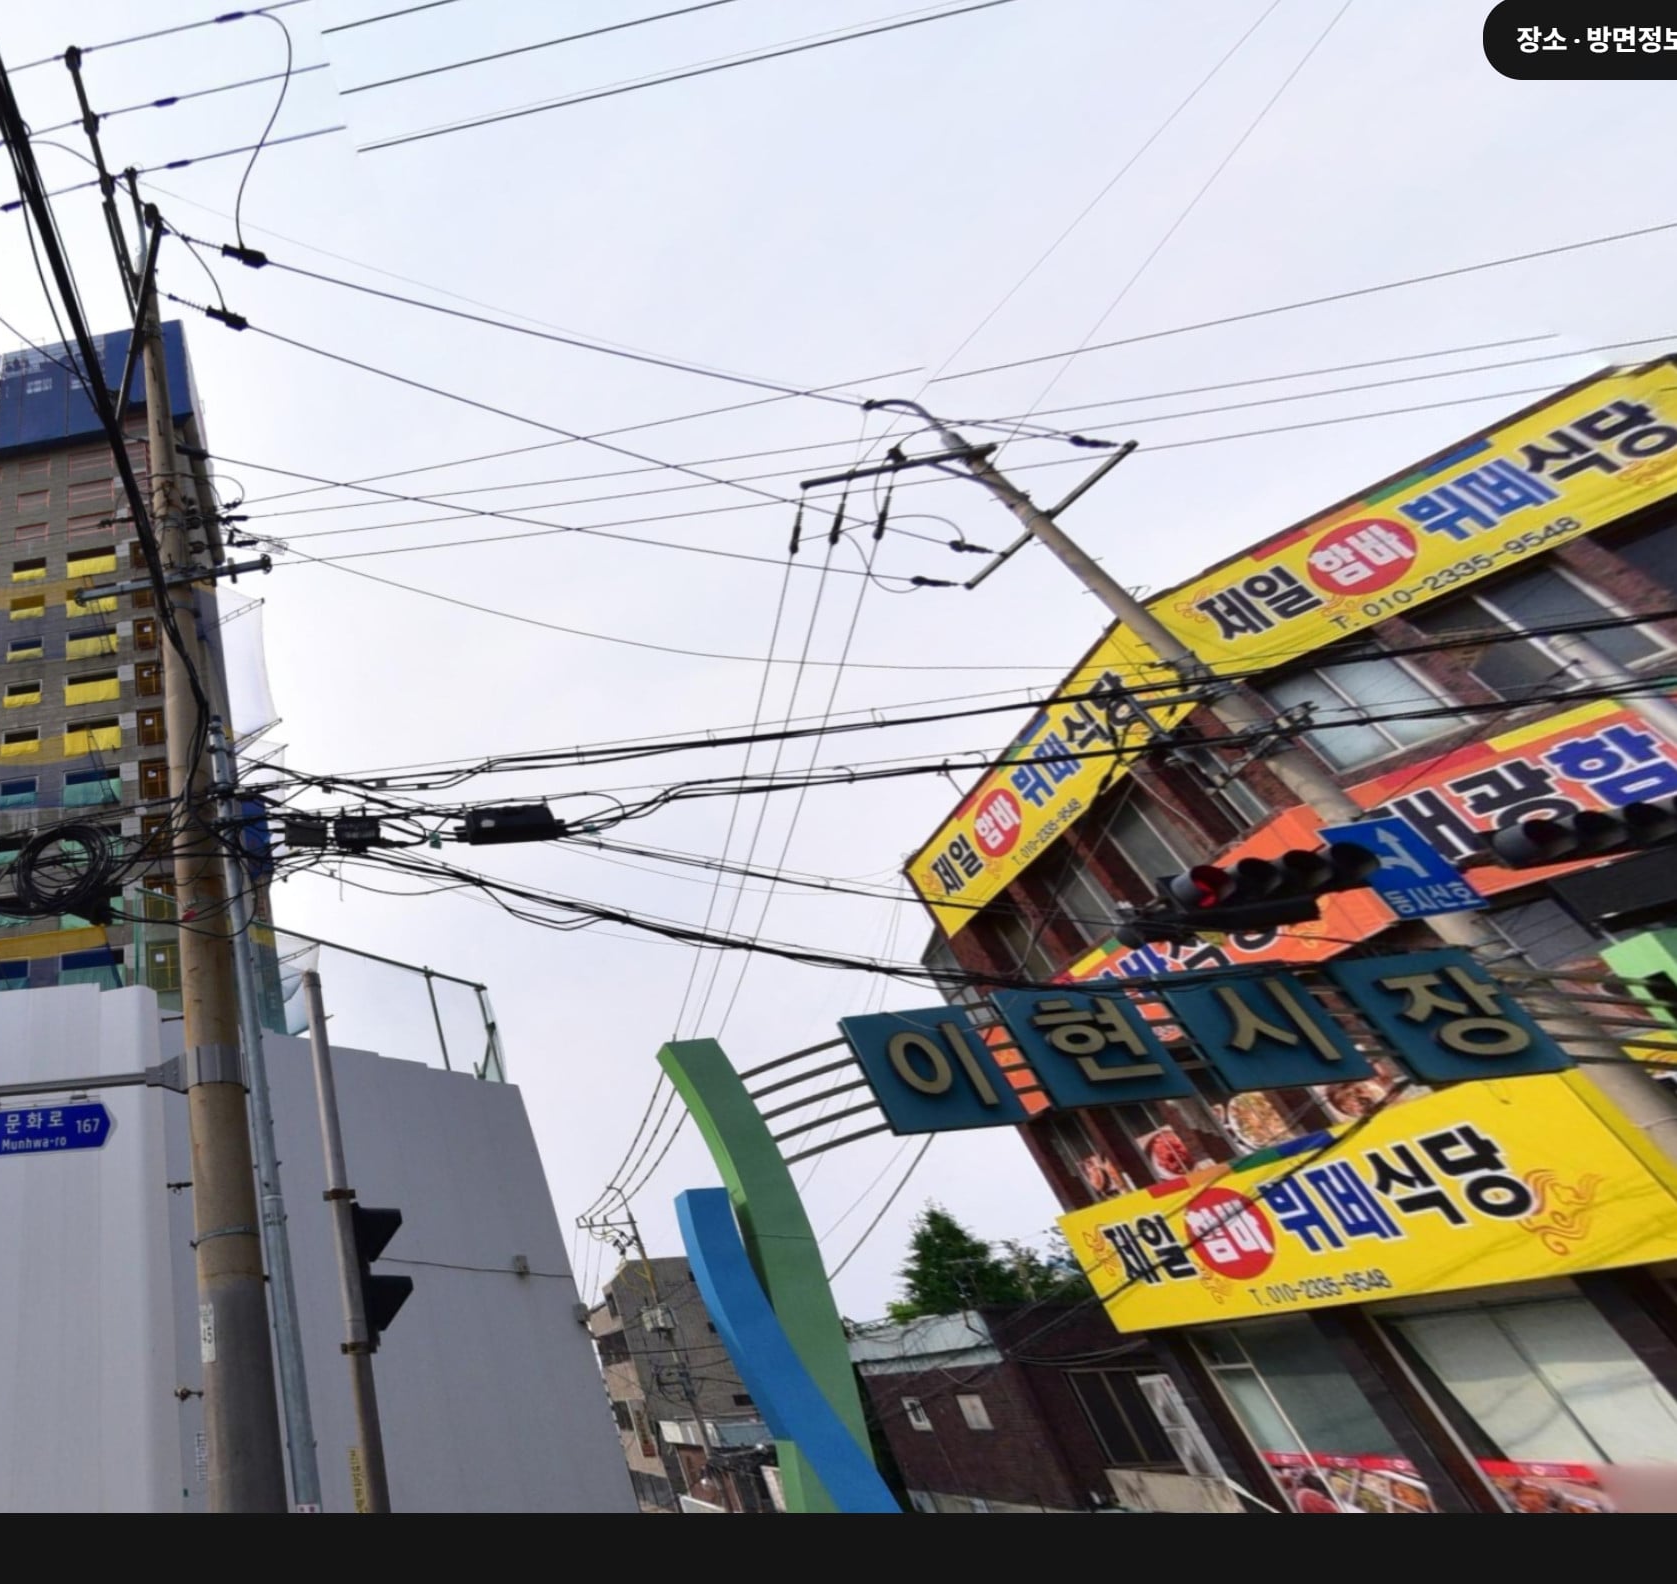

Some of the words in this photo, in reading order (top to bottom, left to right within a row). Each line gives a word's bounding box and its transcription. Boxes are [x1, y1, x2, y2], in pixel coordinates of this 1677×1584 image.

[1195, 564, 1325, 641] 제일
[1307, 523, 1417, 587] 함바
[931, 832, 986, 897] 제일
[974, 794, 1022, 851] 함바
[1382, 881, 1484, 915] 동시신호
[887, 964, 1533, 1107] 이현시장
[1, 1135, 68, 1152] Munhwa-ro
[4, 1110, 65, 1135] 문화로
[75, 1118, 101, 1135] 167
[1102, 1213, 1200, 1285] 제일
[1184, 1199, 1276, 1264] 함바
